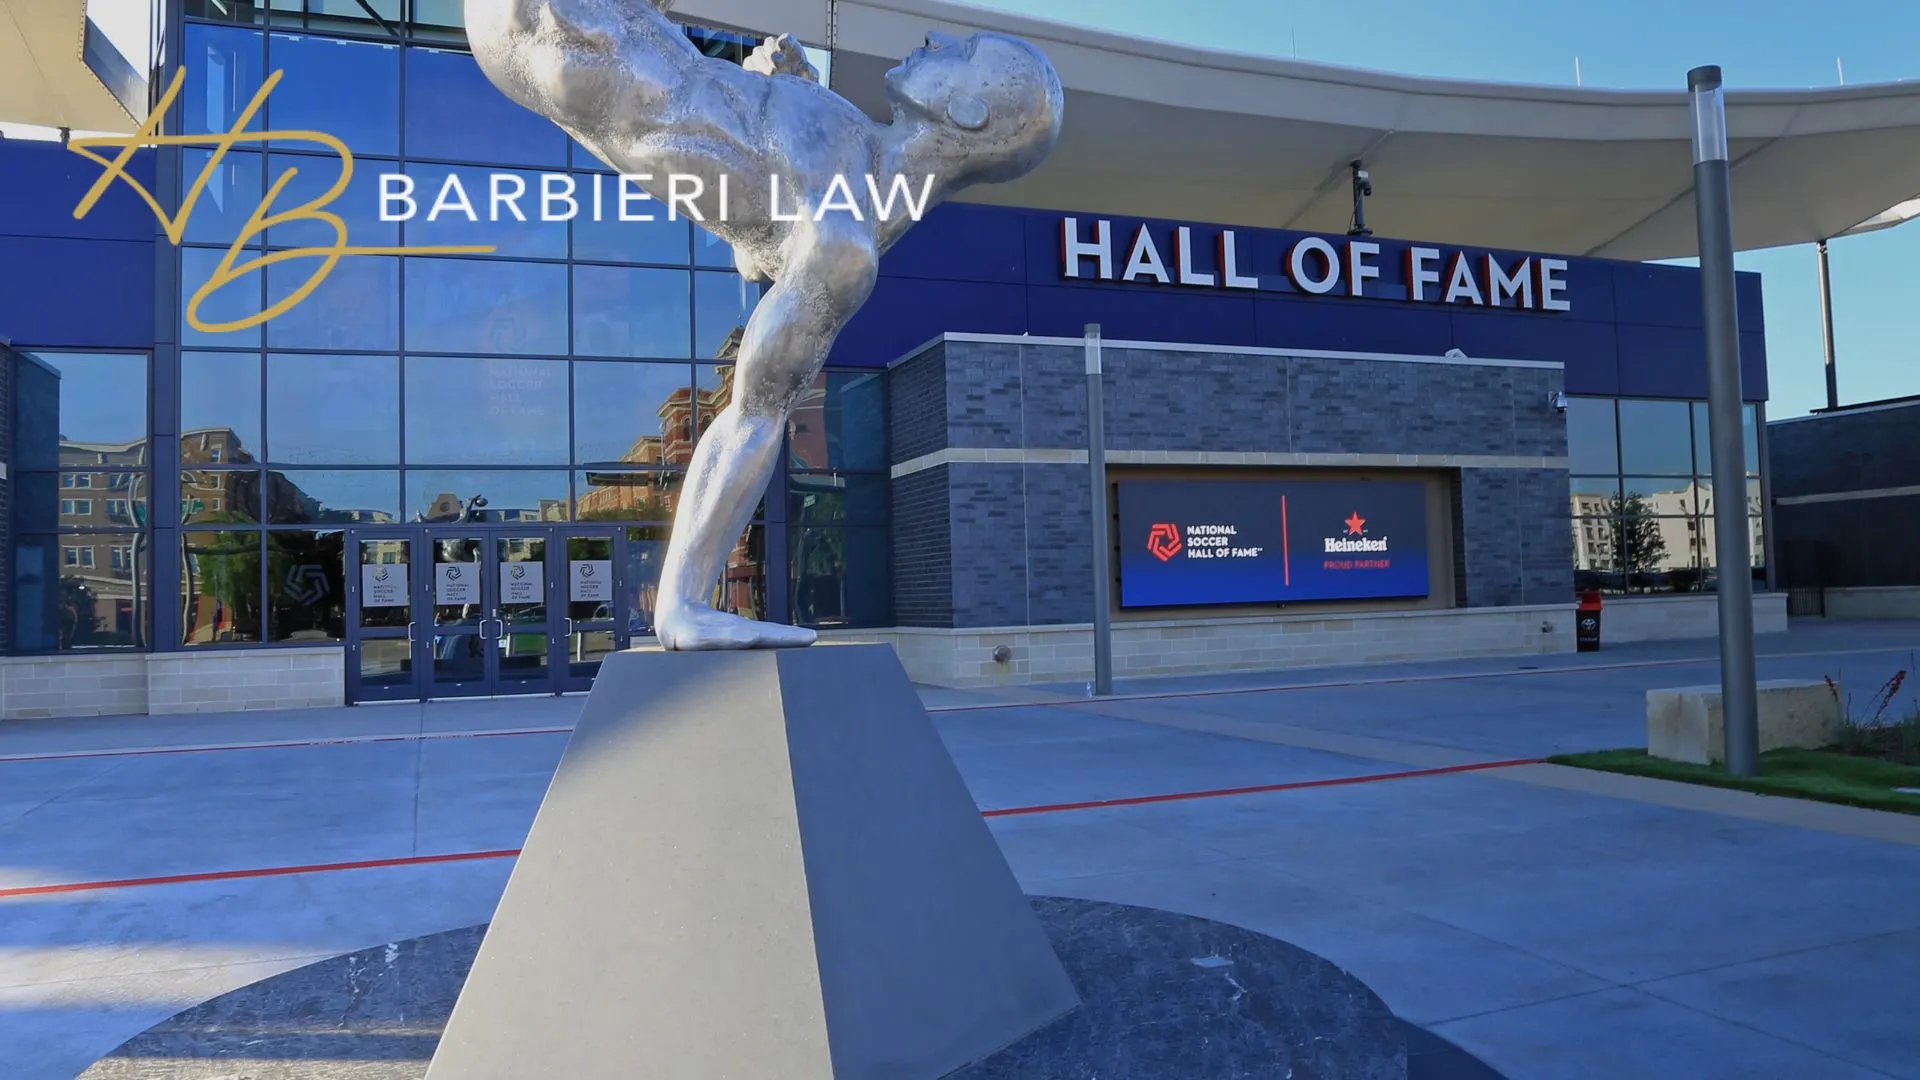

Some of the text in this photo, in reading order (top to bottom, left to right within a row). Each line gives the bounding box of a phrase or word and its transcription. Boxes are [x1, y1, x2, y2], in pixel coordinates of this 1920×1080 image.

[1061, 217, 1571, 312] HALL OF FAME
[1186, 525, 1237, 535] NATIONAL
[1187, 537, 1228, 547] SOCCER
[1324, 536, 1387, 553] Heineken
[1187, 548, 1214, 559] HALL
[1215, 548, 1231, 558] OF
[1323, 559, 1391, 570] PROUD PARTNER
